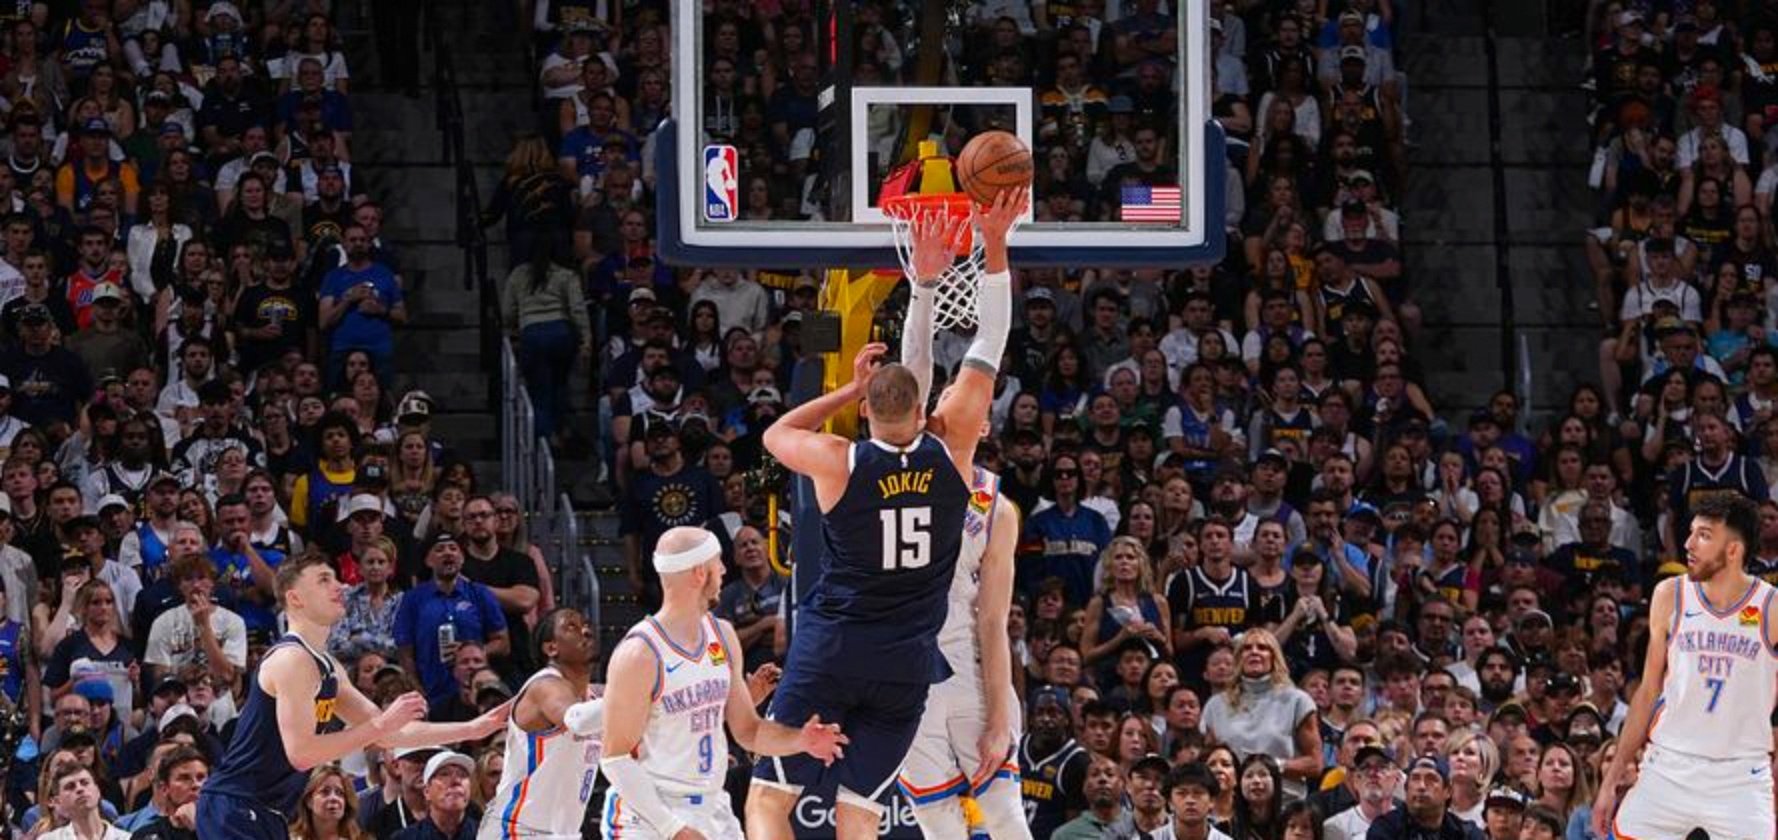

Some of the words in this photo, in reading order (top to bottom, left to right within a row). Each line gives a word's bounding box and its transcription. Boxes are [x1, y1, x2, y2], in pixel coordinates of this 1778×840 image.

[878, 467, 934, 499] JOKIĆ
[880, 506, 932, 569] 15
[1678, 631, 1761, 660] OKLAHOMA
[1698, 655, 1735, 677] CITY
[1705, 678, 1726, 713] 7
[690, 704, 721, 733] CITY
[698, 735, 713, 773] 9
[796, 795, 918, 835] Ggle
